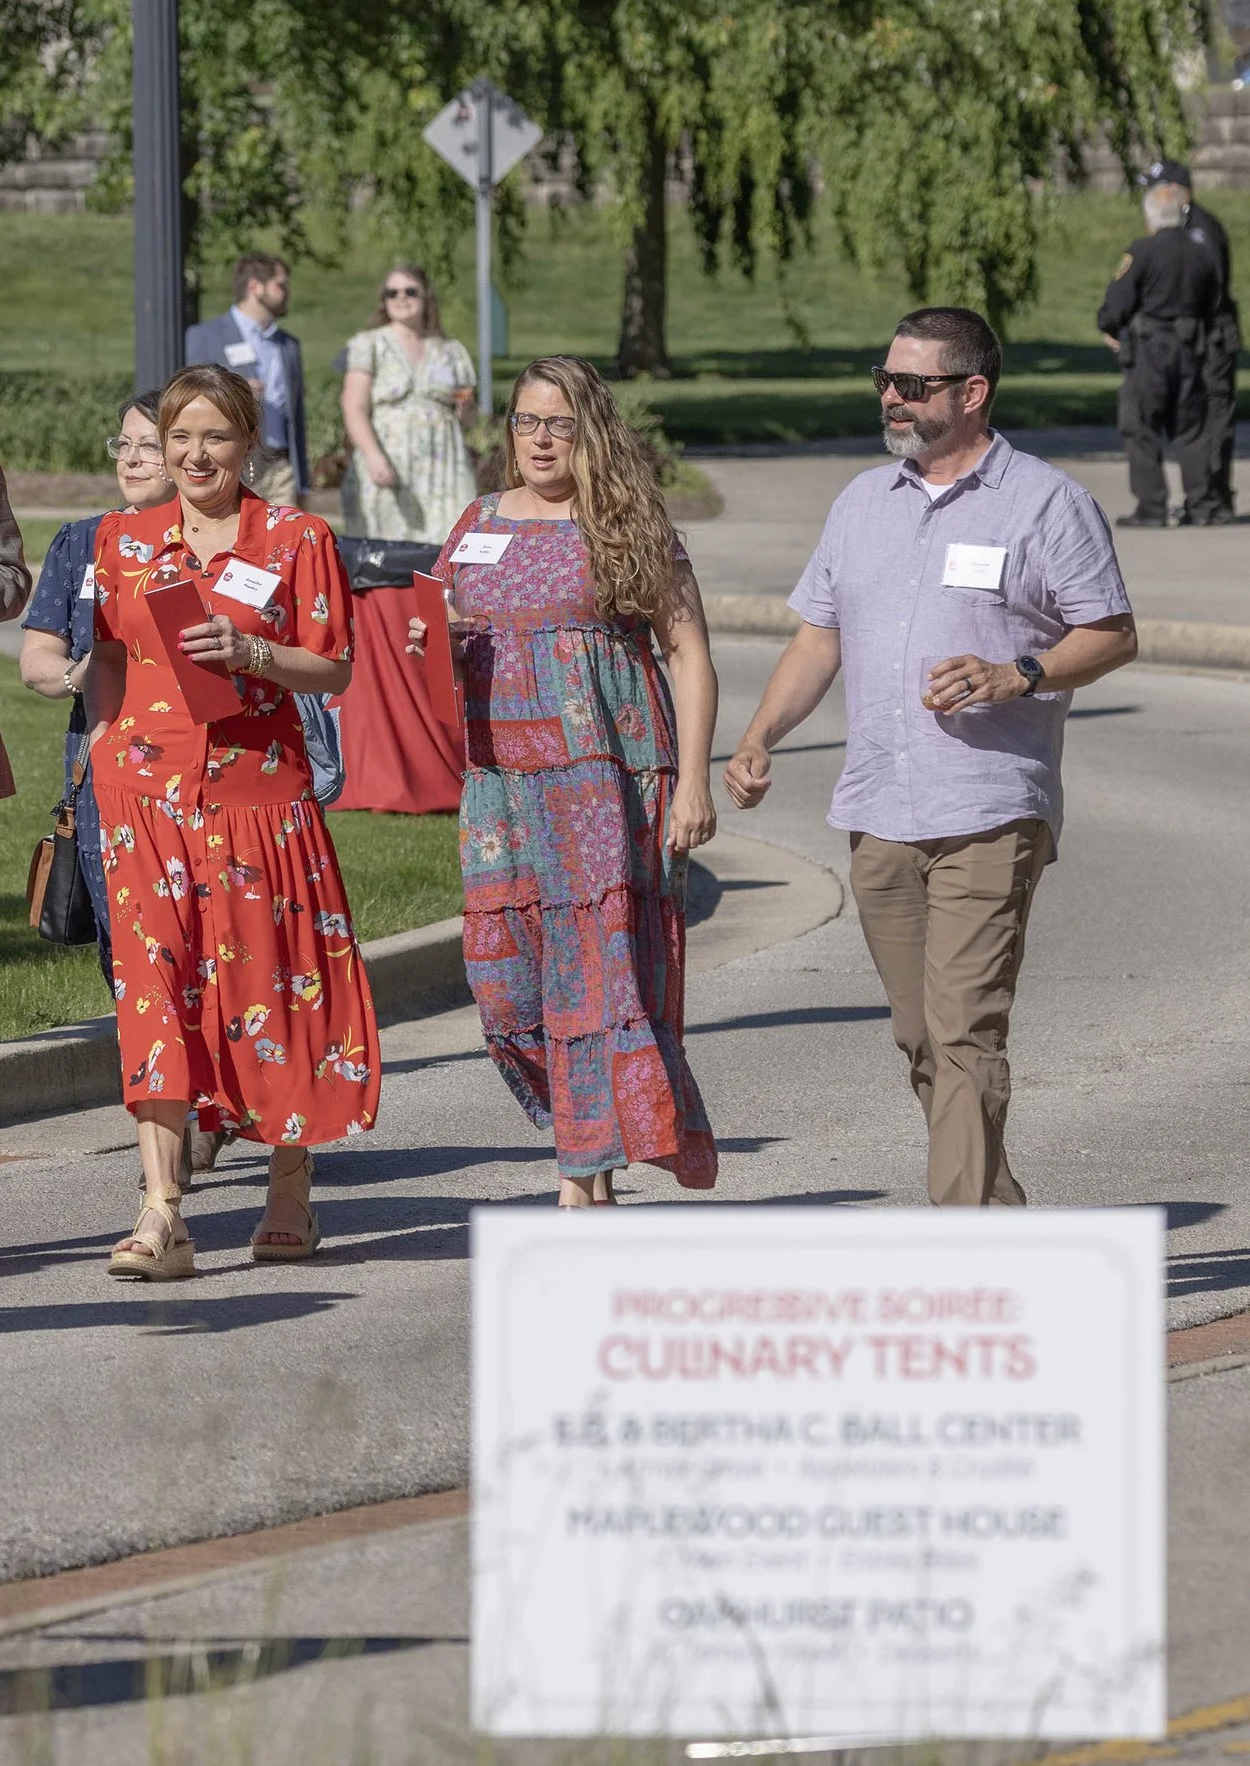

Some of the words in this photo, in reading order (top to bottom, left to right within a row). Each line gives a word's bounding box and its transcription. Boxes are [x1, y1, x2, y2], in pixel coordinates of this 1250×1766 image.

[612, 1288, 872, 1324] PROGRESSIVE
[597, 1333, 853, 1381] CULINARY
[865, 1333, 1038, 1381] TENTS
[650, 1413, 795, 1448] BERTHA
[840, 1413, 931, 1448] BALL
[935, 1413, 1082, 1448] CENTER
[566, 1505, 809, 1541] MAPLEWOOD
[816, 1505, 932, 1541] GUEST
[940, 1505, 1069, 1541] HOUSE
[866, 1597, 976, 1633] PATIO
